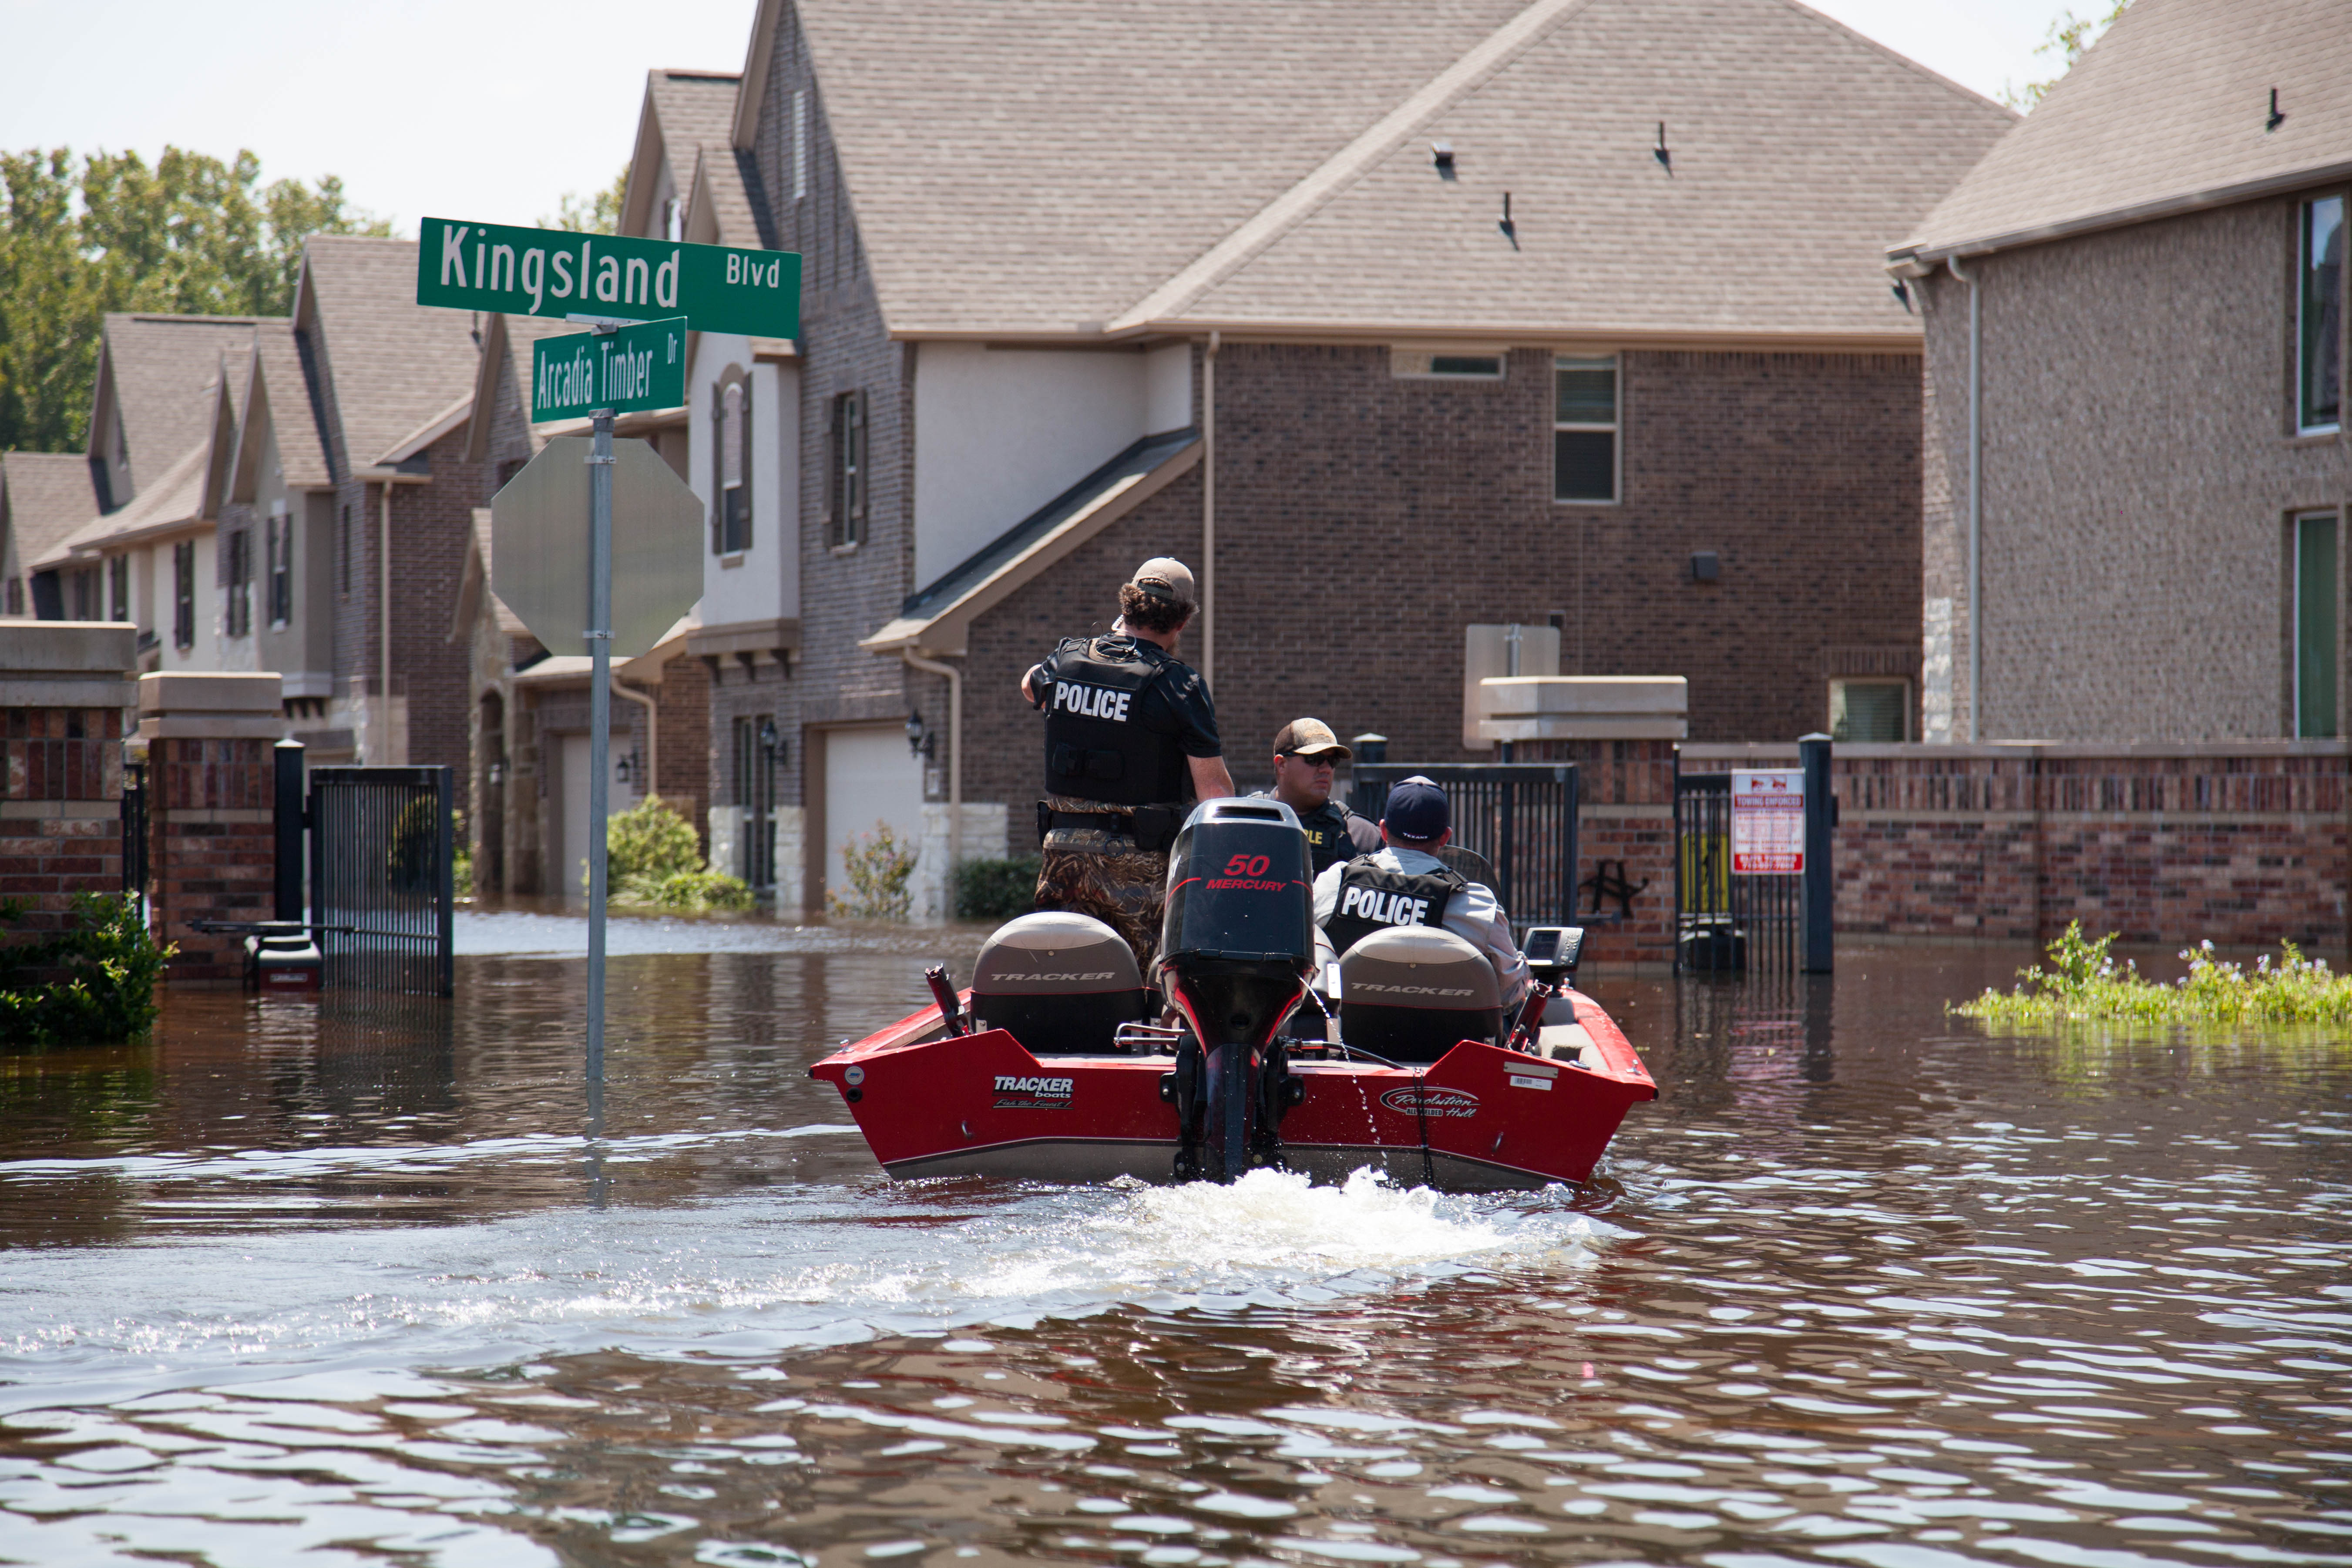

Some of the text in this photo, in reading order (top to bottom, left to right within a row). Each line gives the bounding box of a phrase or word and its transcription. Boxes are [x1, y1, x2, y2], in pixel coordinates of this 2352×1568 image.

[441, 225, 780, 315] Kingsland Blvd
[537, 332, 678, 410] Arcadia Timber Dr
[1053, 682, 1131, 722] POLICE
[1737, 797, 1764, 806] TOWING
[1224, 854, 1270, 876] 50
[1206, 879, 1287, 892] MERCURY
[1341, 886, 1429, 926] POLICE
[991, 971, 1116, 981] TRACKER
[1351, 982, 1475, 996] TRACKER
[995, 1076, 1073, 1092] TRACKER
[1446, 1108, 1476, 1118] Hull
